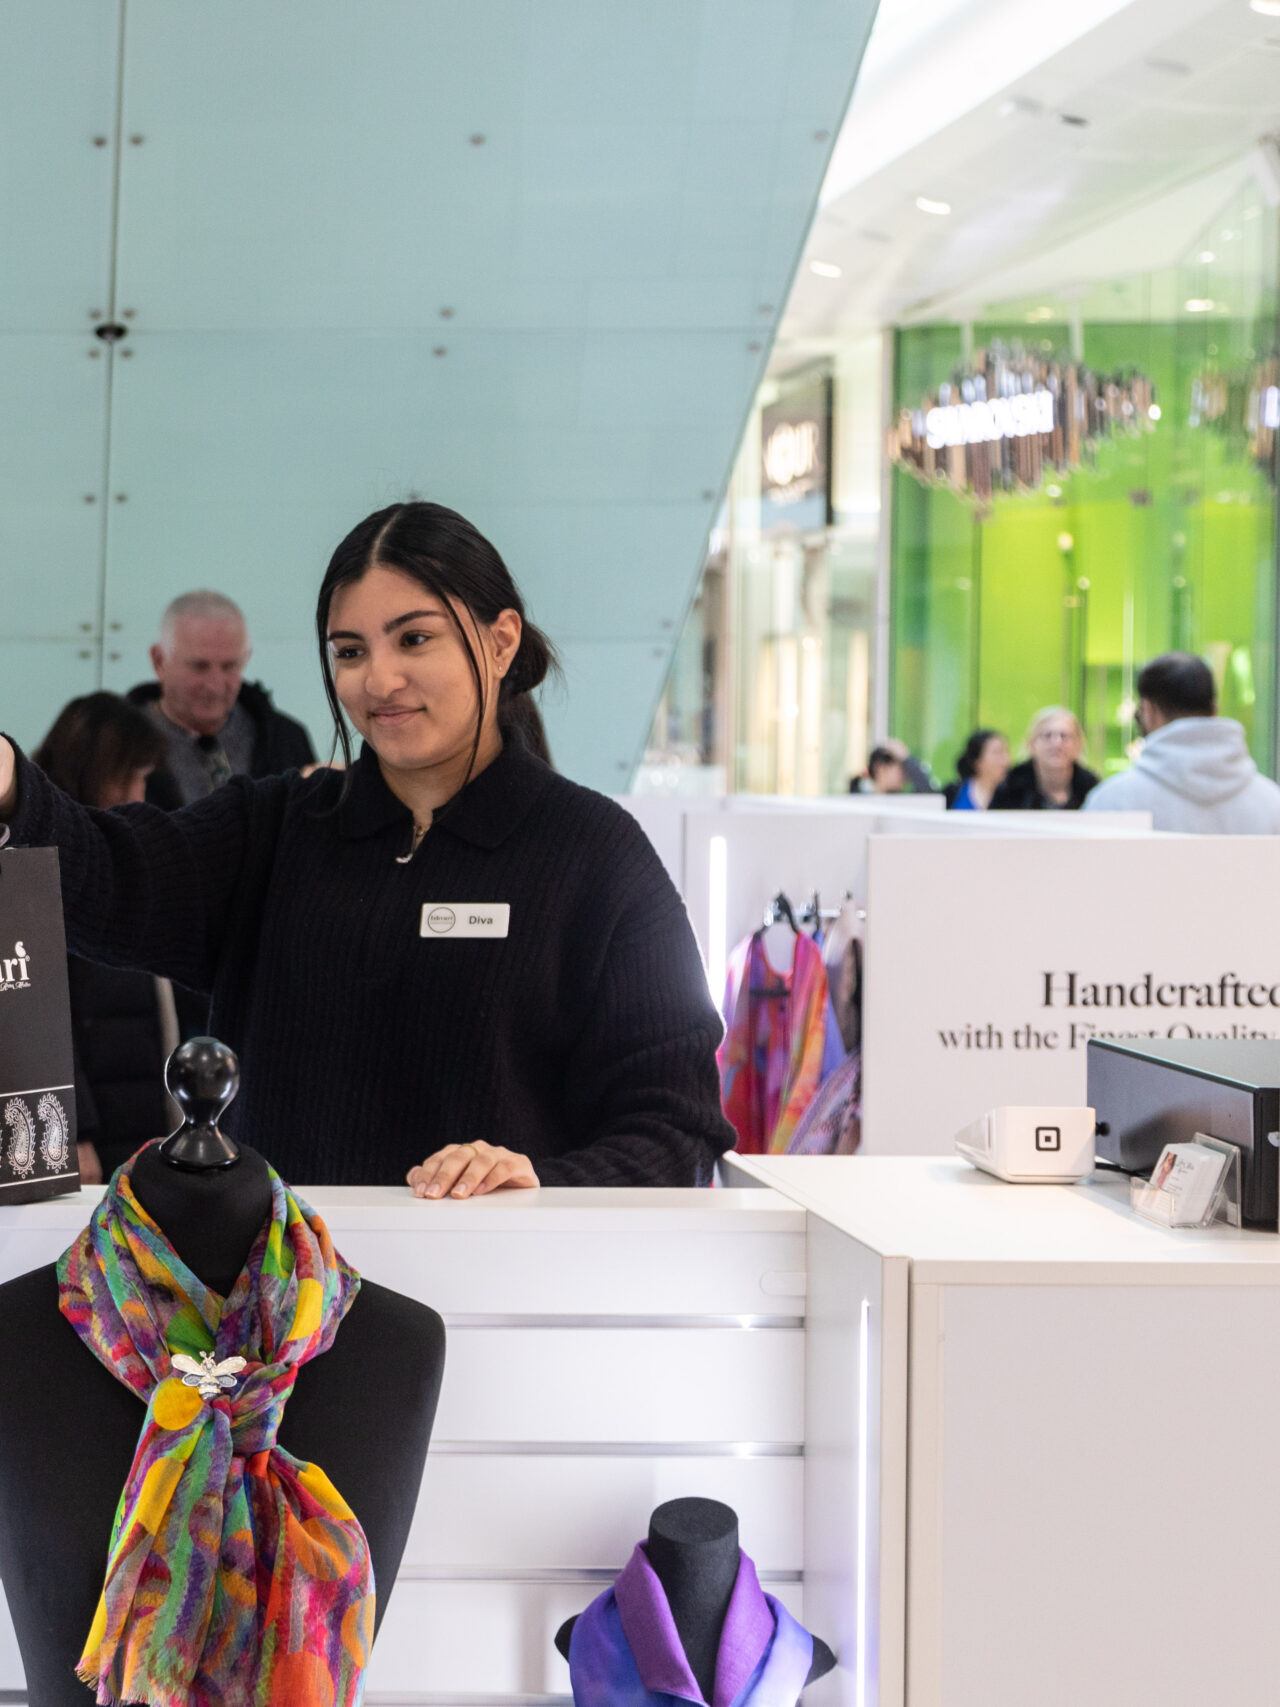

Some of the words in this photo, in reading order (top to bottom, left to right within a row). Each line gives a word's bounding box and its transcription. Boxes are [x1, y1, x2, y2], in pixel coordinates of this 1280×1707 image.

[469, 916, 493, 925] Diva
[938, 1023, 1004, 1050] with
[1013, 1023, 1059, 1050] the
